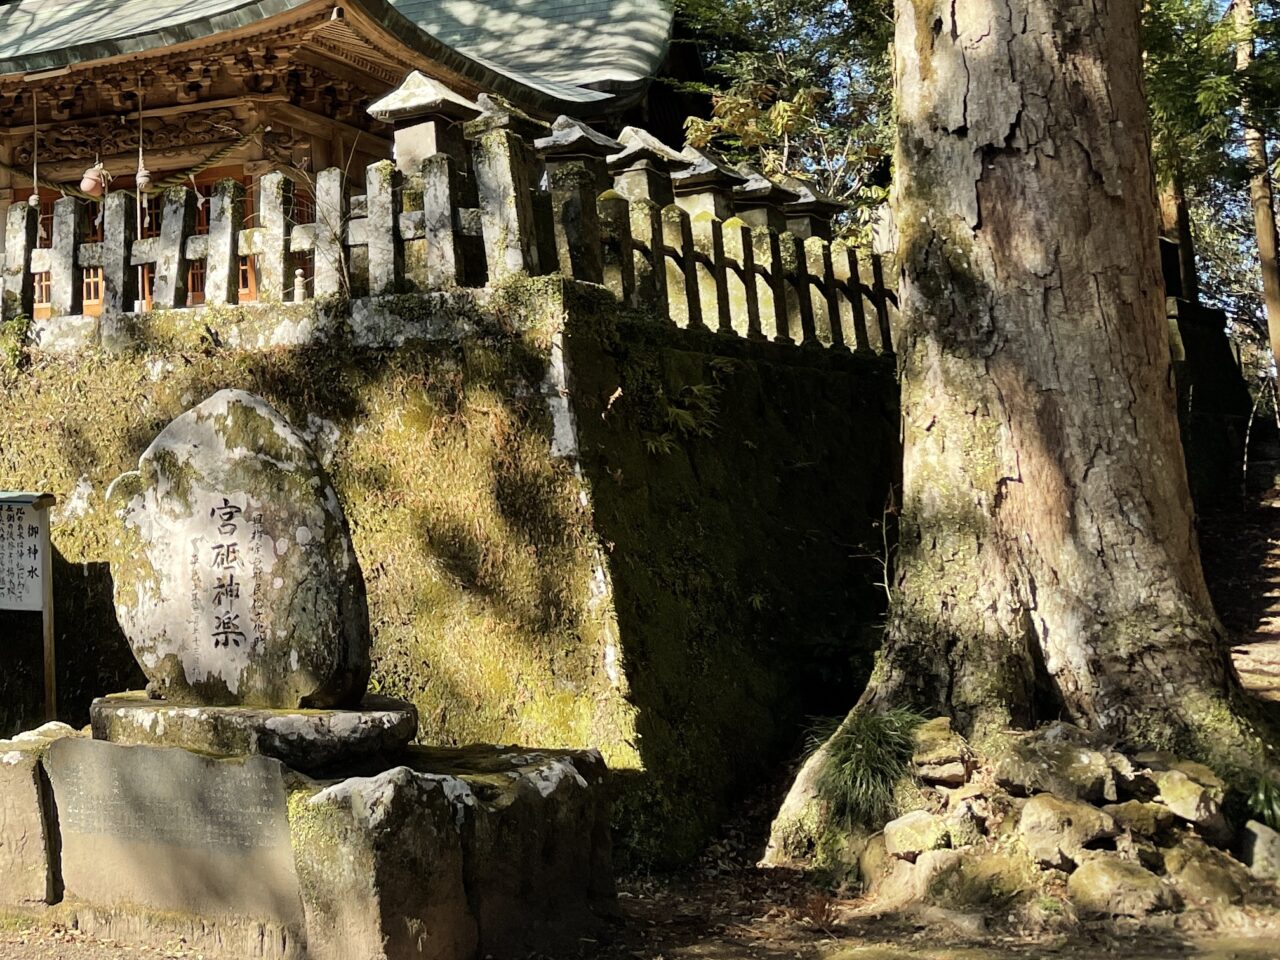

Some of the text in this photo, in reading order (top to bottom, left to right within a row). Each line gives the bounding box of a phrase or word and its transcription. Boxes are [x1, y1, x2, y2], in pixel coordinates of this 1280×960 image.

[27, 524, 40, 579] 御神水
[210, 498, 247, 649] 宮砥神楽
